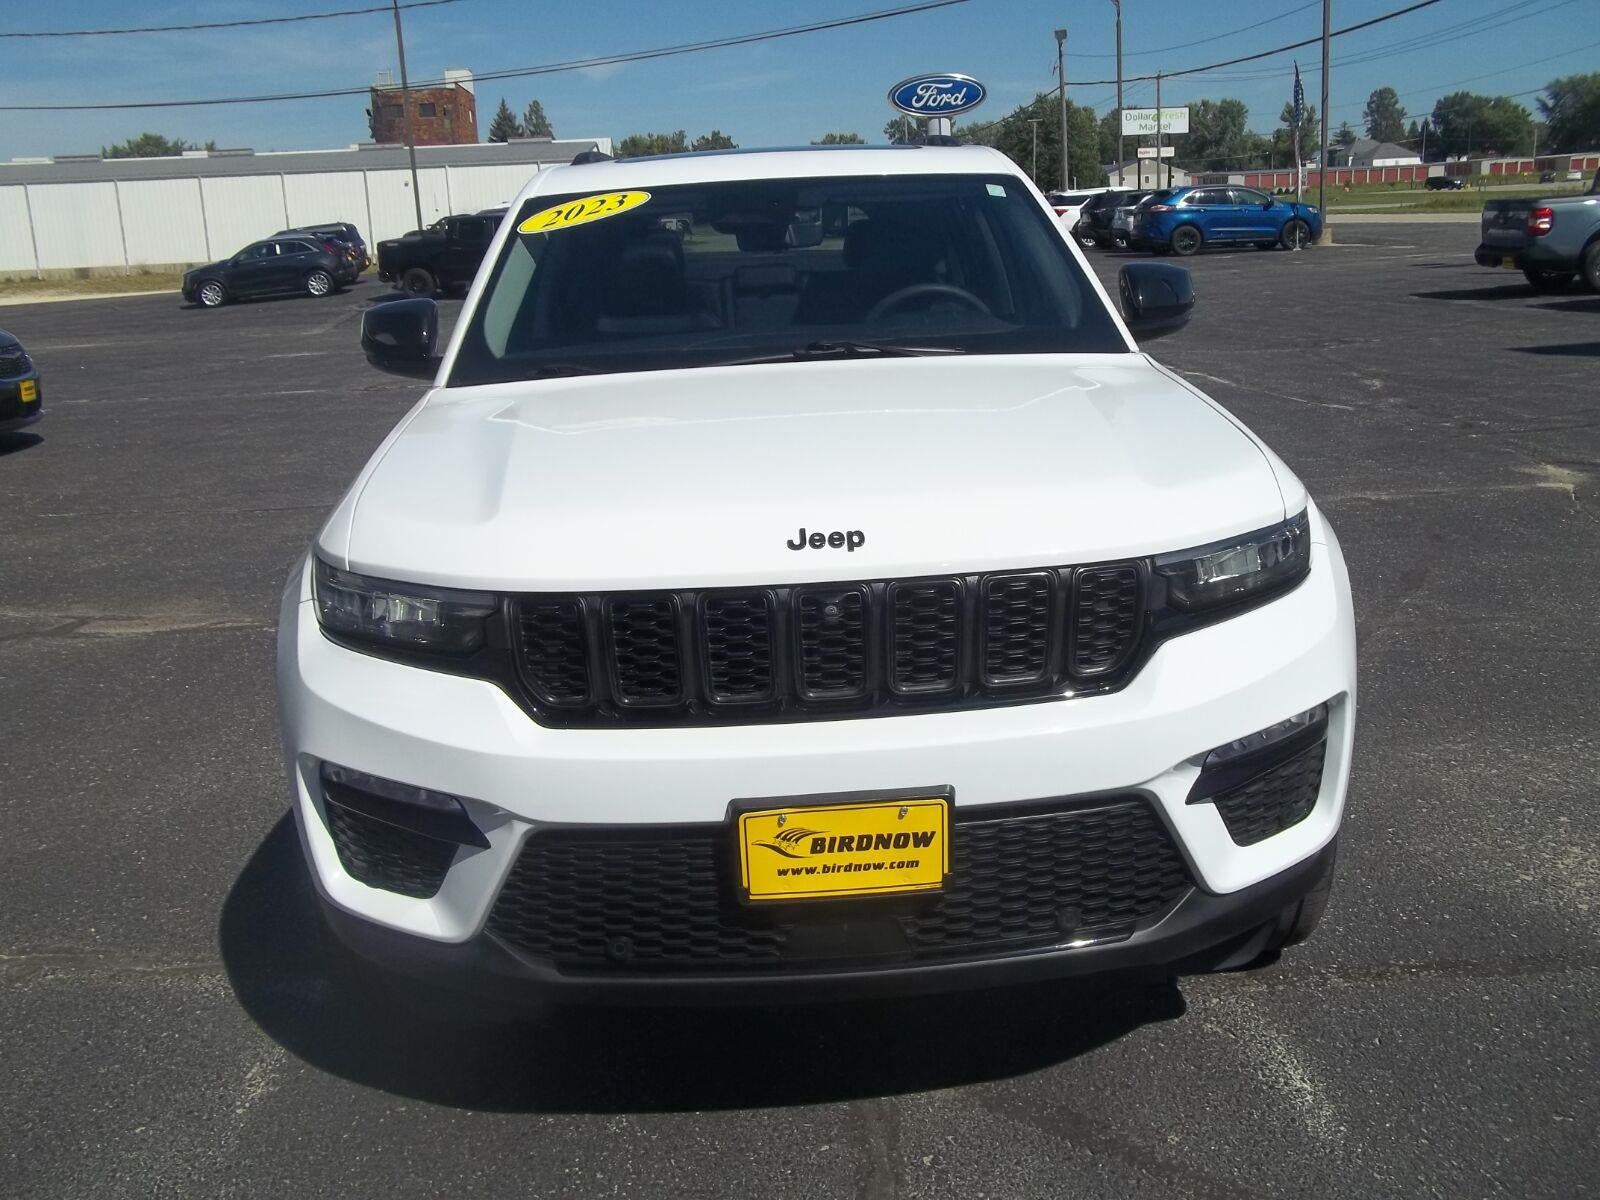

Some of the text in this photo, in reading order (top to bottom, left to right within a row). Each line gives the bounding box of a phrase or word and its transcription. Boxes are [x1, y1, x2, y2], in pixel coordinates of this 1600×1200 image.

[911, 82, 967, 108] Ford
[1125, 110, 1186, 121] Dollar Fresh
[541, 194, 629, 229] 2023
[786, 527, 866, 552] Jeep
[810, 830, 937, 855] BIRDNOW
[776, 858, 920, 878] www.birdnow.com
